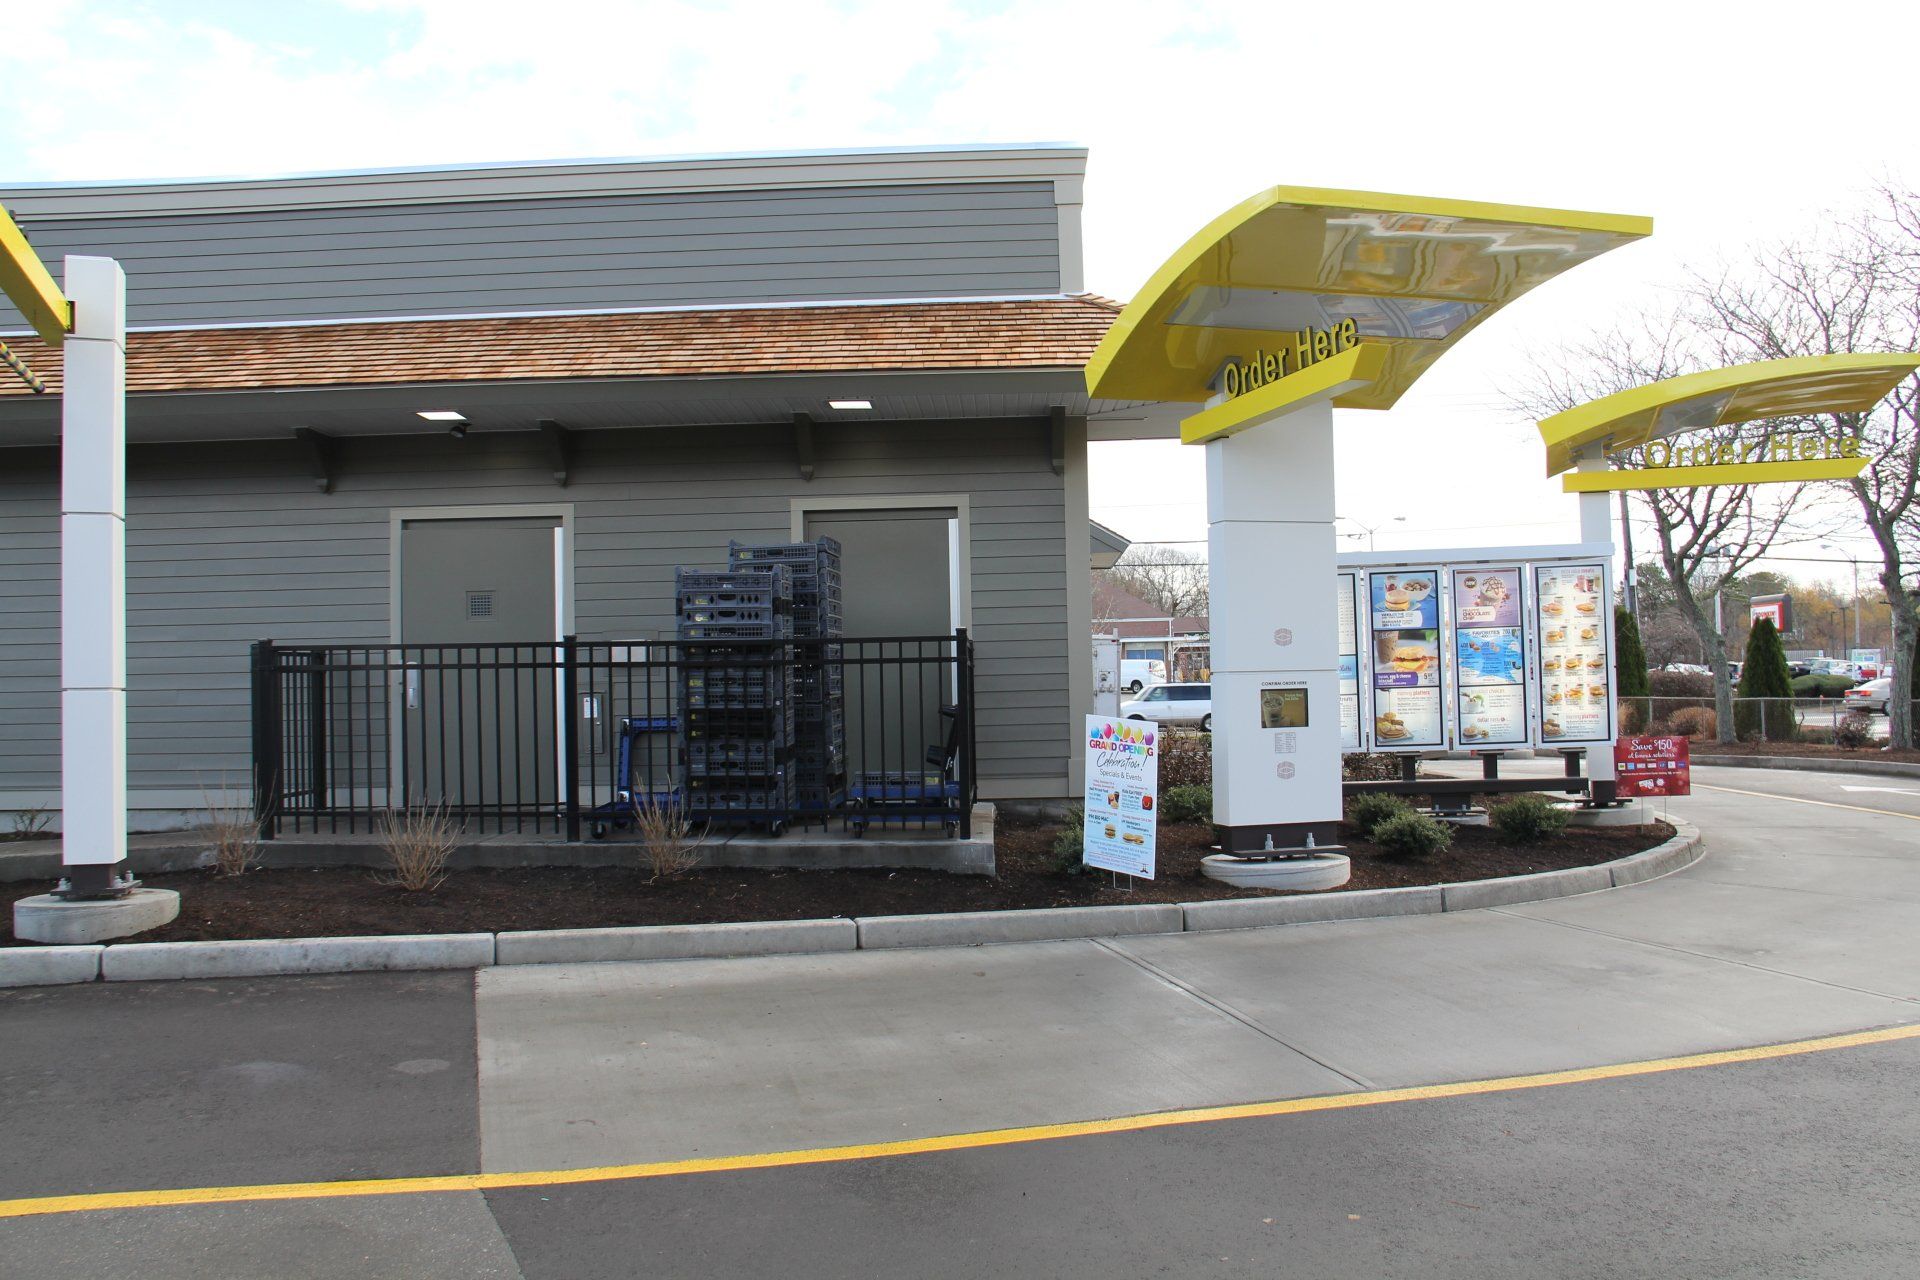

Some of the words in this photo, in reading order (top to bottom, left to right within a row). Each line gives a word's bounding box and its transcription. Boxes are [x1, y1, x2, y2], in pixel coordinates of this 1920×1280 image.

[1223, 347, 1290, 399] Order
[1295, 317, 1360, 370] Here
[1644, 439, 1752, 469] Order
[1769, 433, 1861, 462] Here
[1089, 739, 1118, 751] GRAND
[1118, 743, 1154, 757] OPENING
[1631, 739, 1653, 751] Save
[1653, 738, 1673, 751] $150
[1096, 751, 1148, 771] Celebration!
[1099, 769, 1120, 779] Specials
[1120, 771, 1125, 779] &
[1125, 773, 1143, 781] Events
